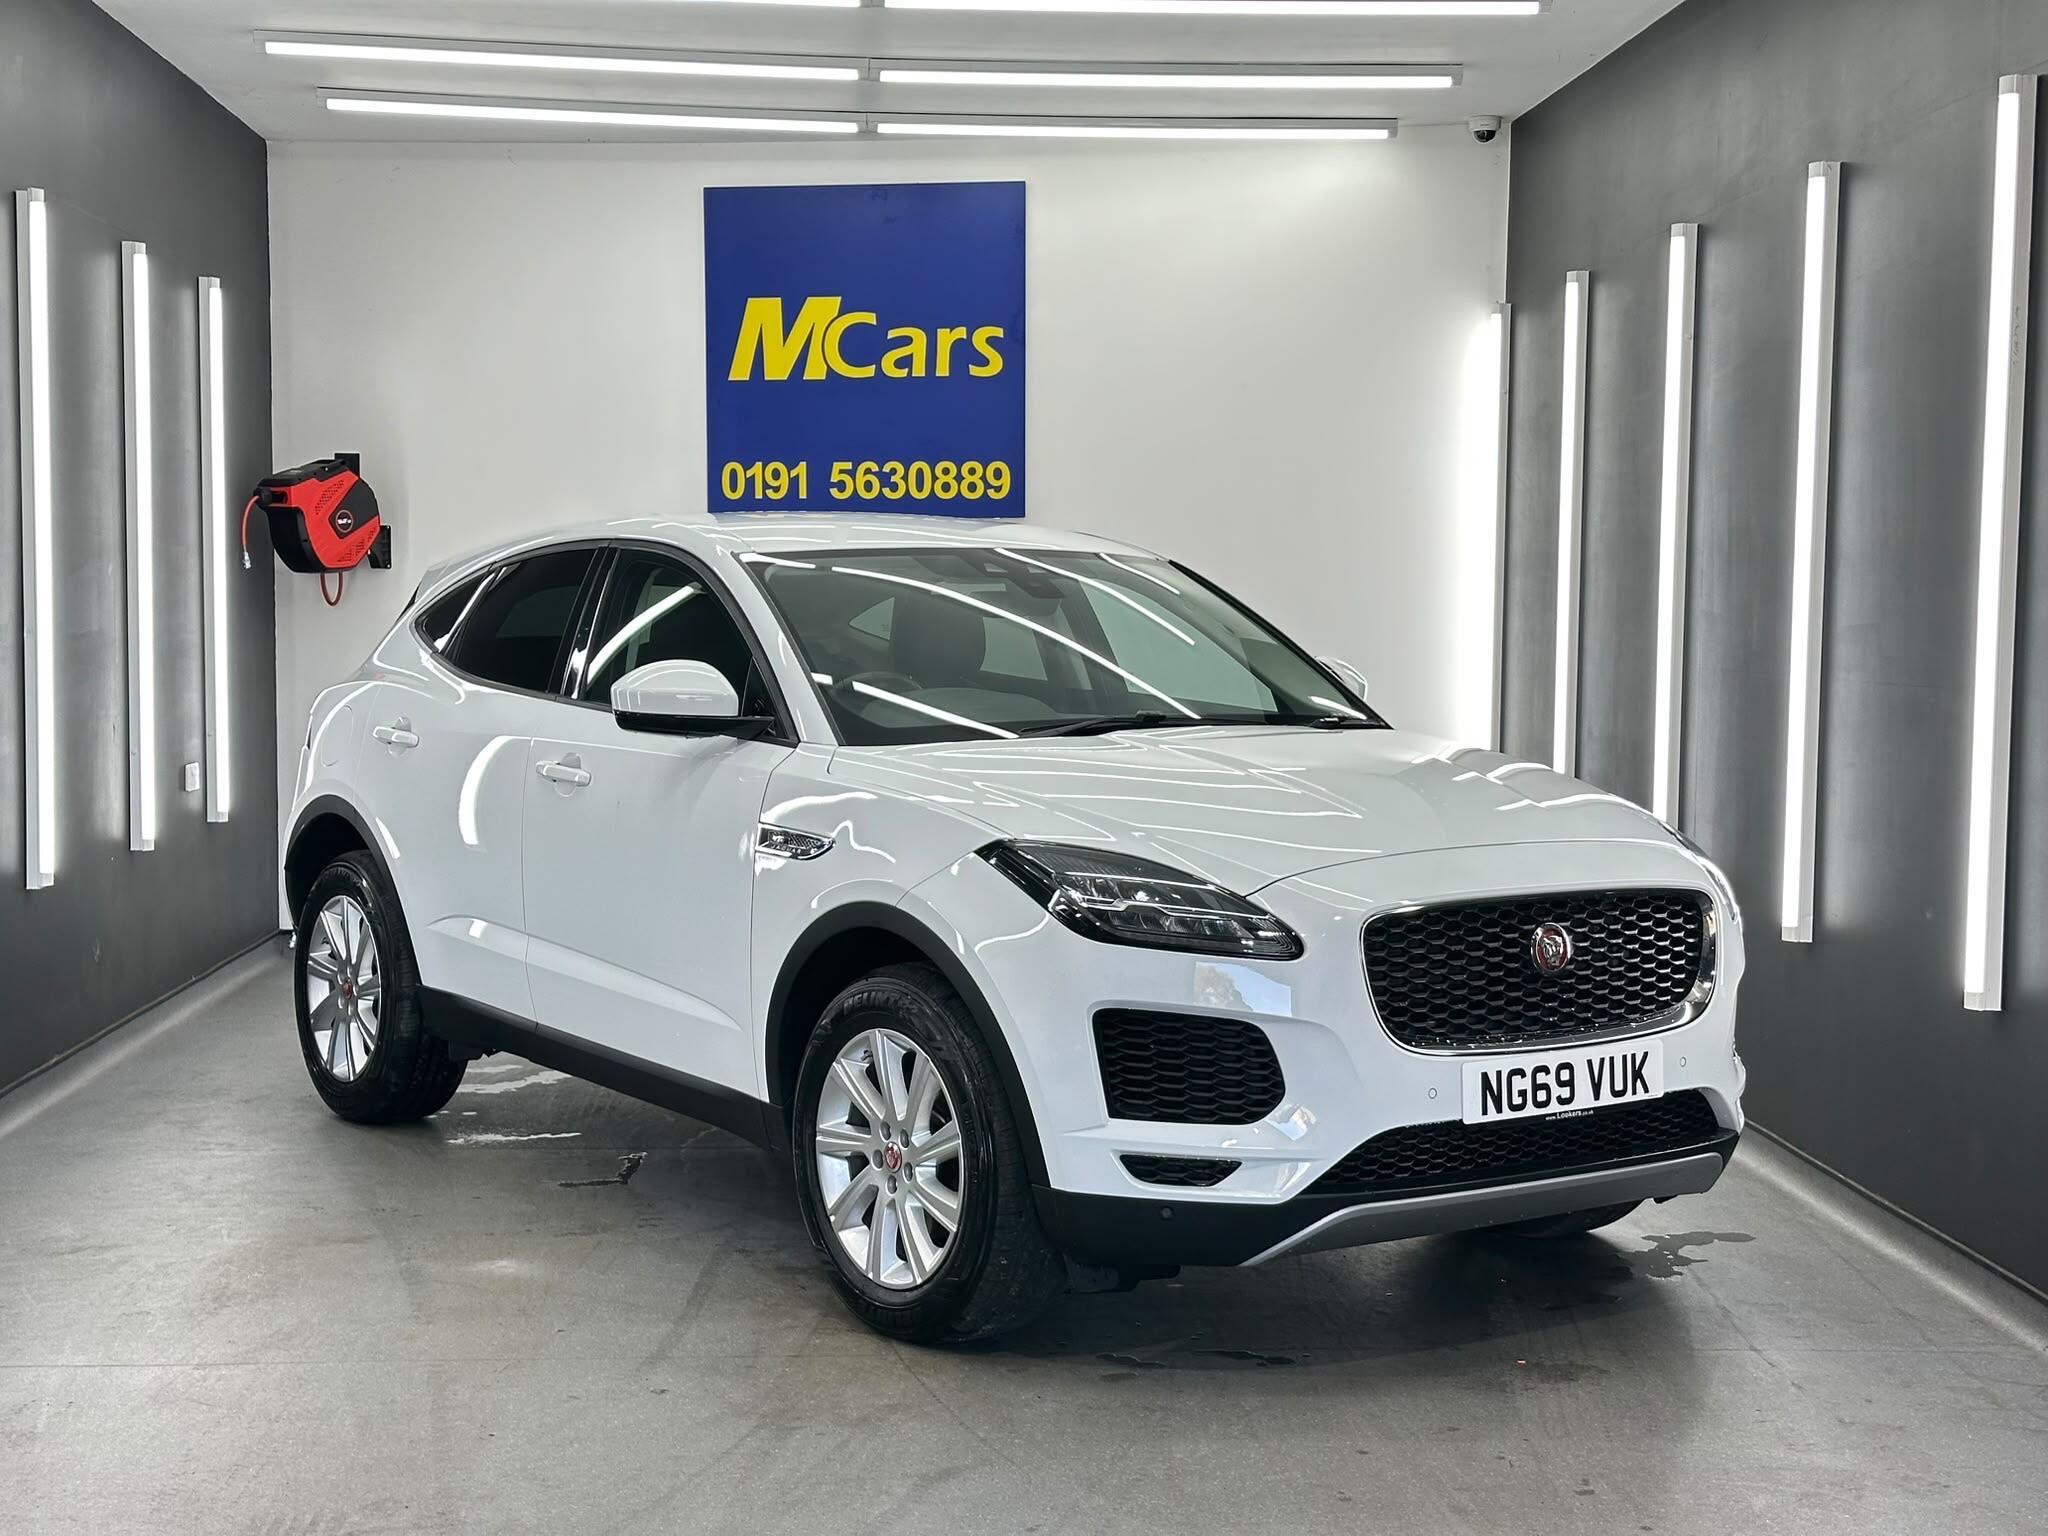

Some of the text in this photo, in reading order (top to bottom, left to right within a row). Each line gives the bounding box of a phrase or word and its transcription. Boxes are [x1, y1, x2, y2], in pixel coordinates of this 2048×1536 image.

[721, 461, 1011, 500] 0191 5630889
[771, 843, 802, 854] JAGUAR
[1481, 1051, 1649, 1116] NG69 VUK
